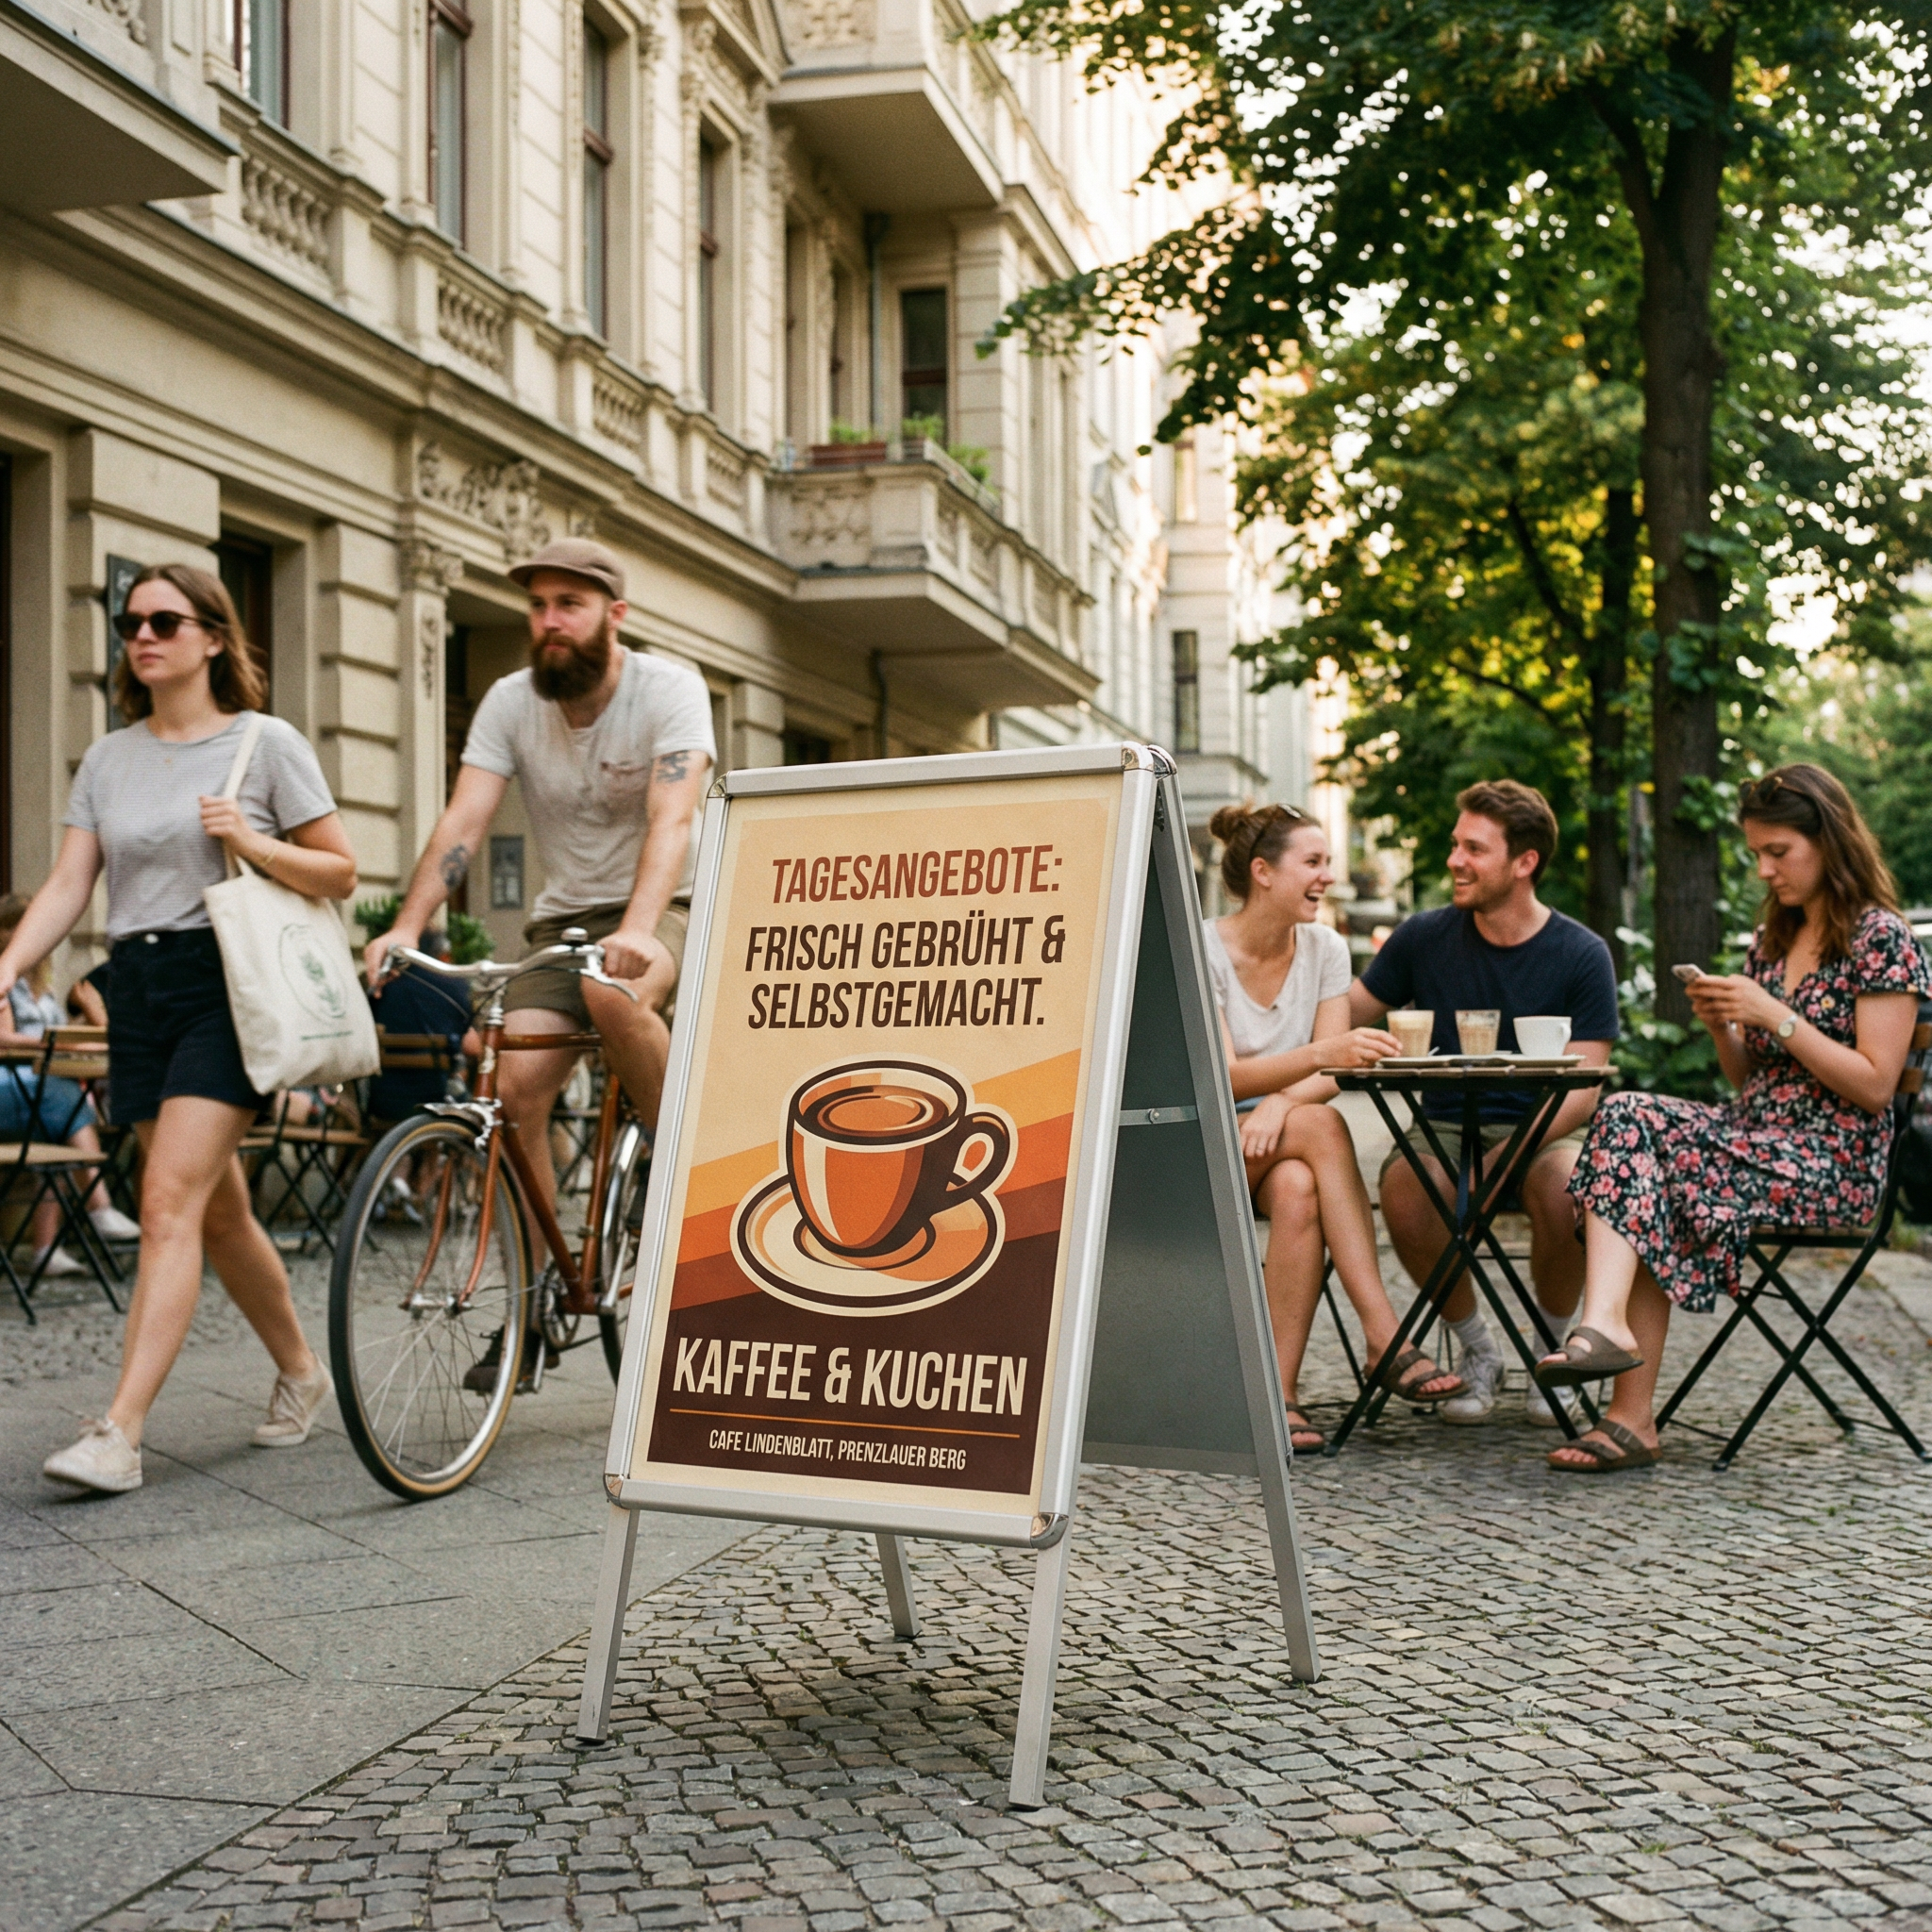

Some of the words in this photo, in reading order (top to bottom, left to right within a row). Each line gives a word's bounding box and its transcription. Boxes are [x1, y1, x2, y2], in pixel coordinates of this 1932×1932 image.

[773, 844, 1062, 904] TAGESANGEBOTE:
[745, 923, 863, 972] FRISCH
[872, 909, 1034, 968] GEBRÜHT
[1041, 915, 1066, 963] &
[748, 977, 1044, 1029] SELBSTGEMACHT.
[673, 1337, 817, 1401] KAFFEE
[824, 1347, 852, 1404] &
[860, 1348, 1027, 1415] KUCHEN
[709, 1429, 742, 1451] CAFE
[744, 1432, 834, 1462] LINDENBLATT,
[838, 1440, 926, 1468] PRENZLAUER
[928, 1447, 966, 1471] BERG
